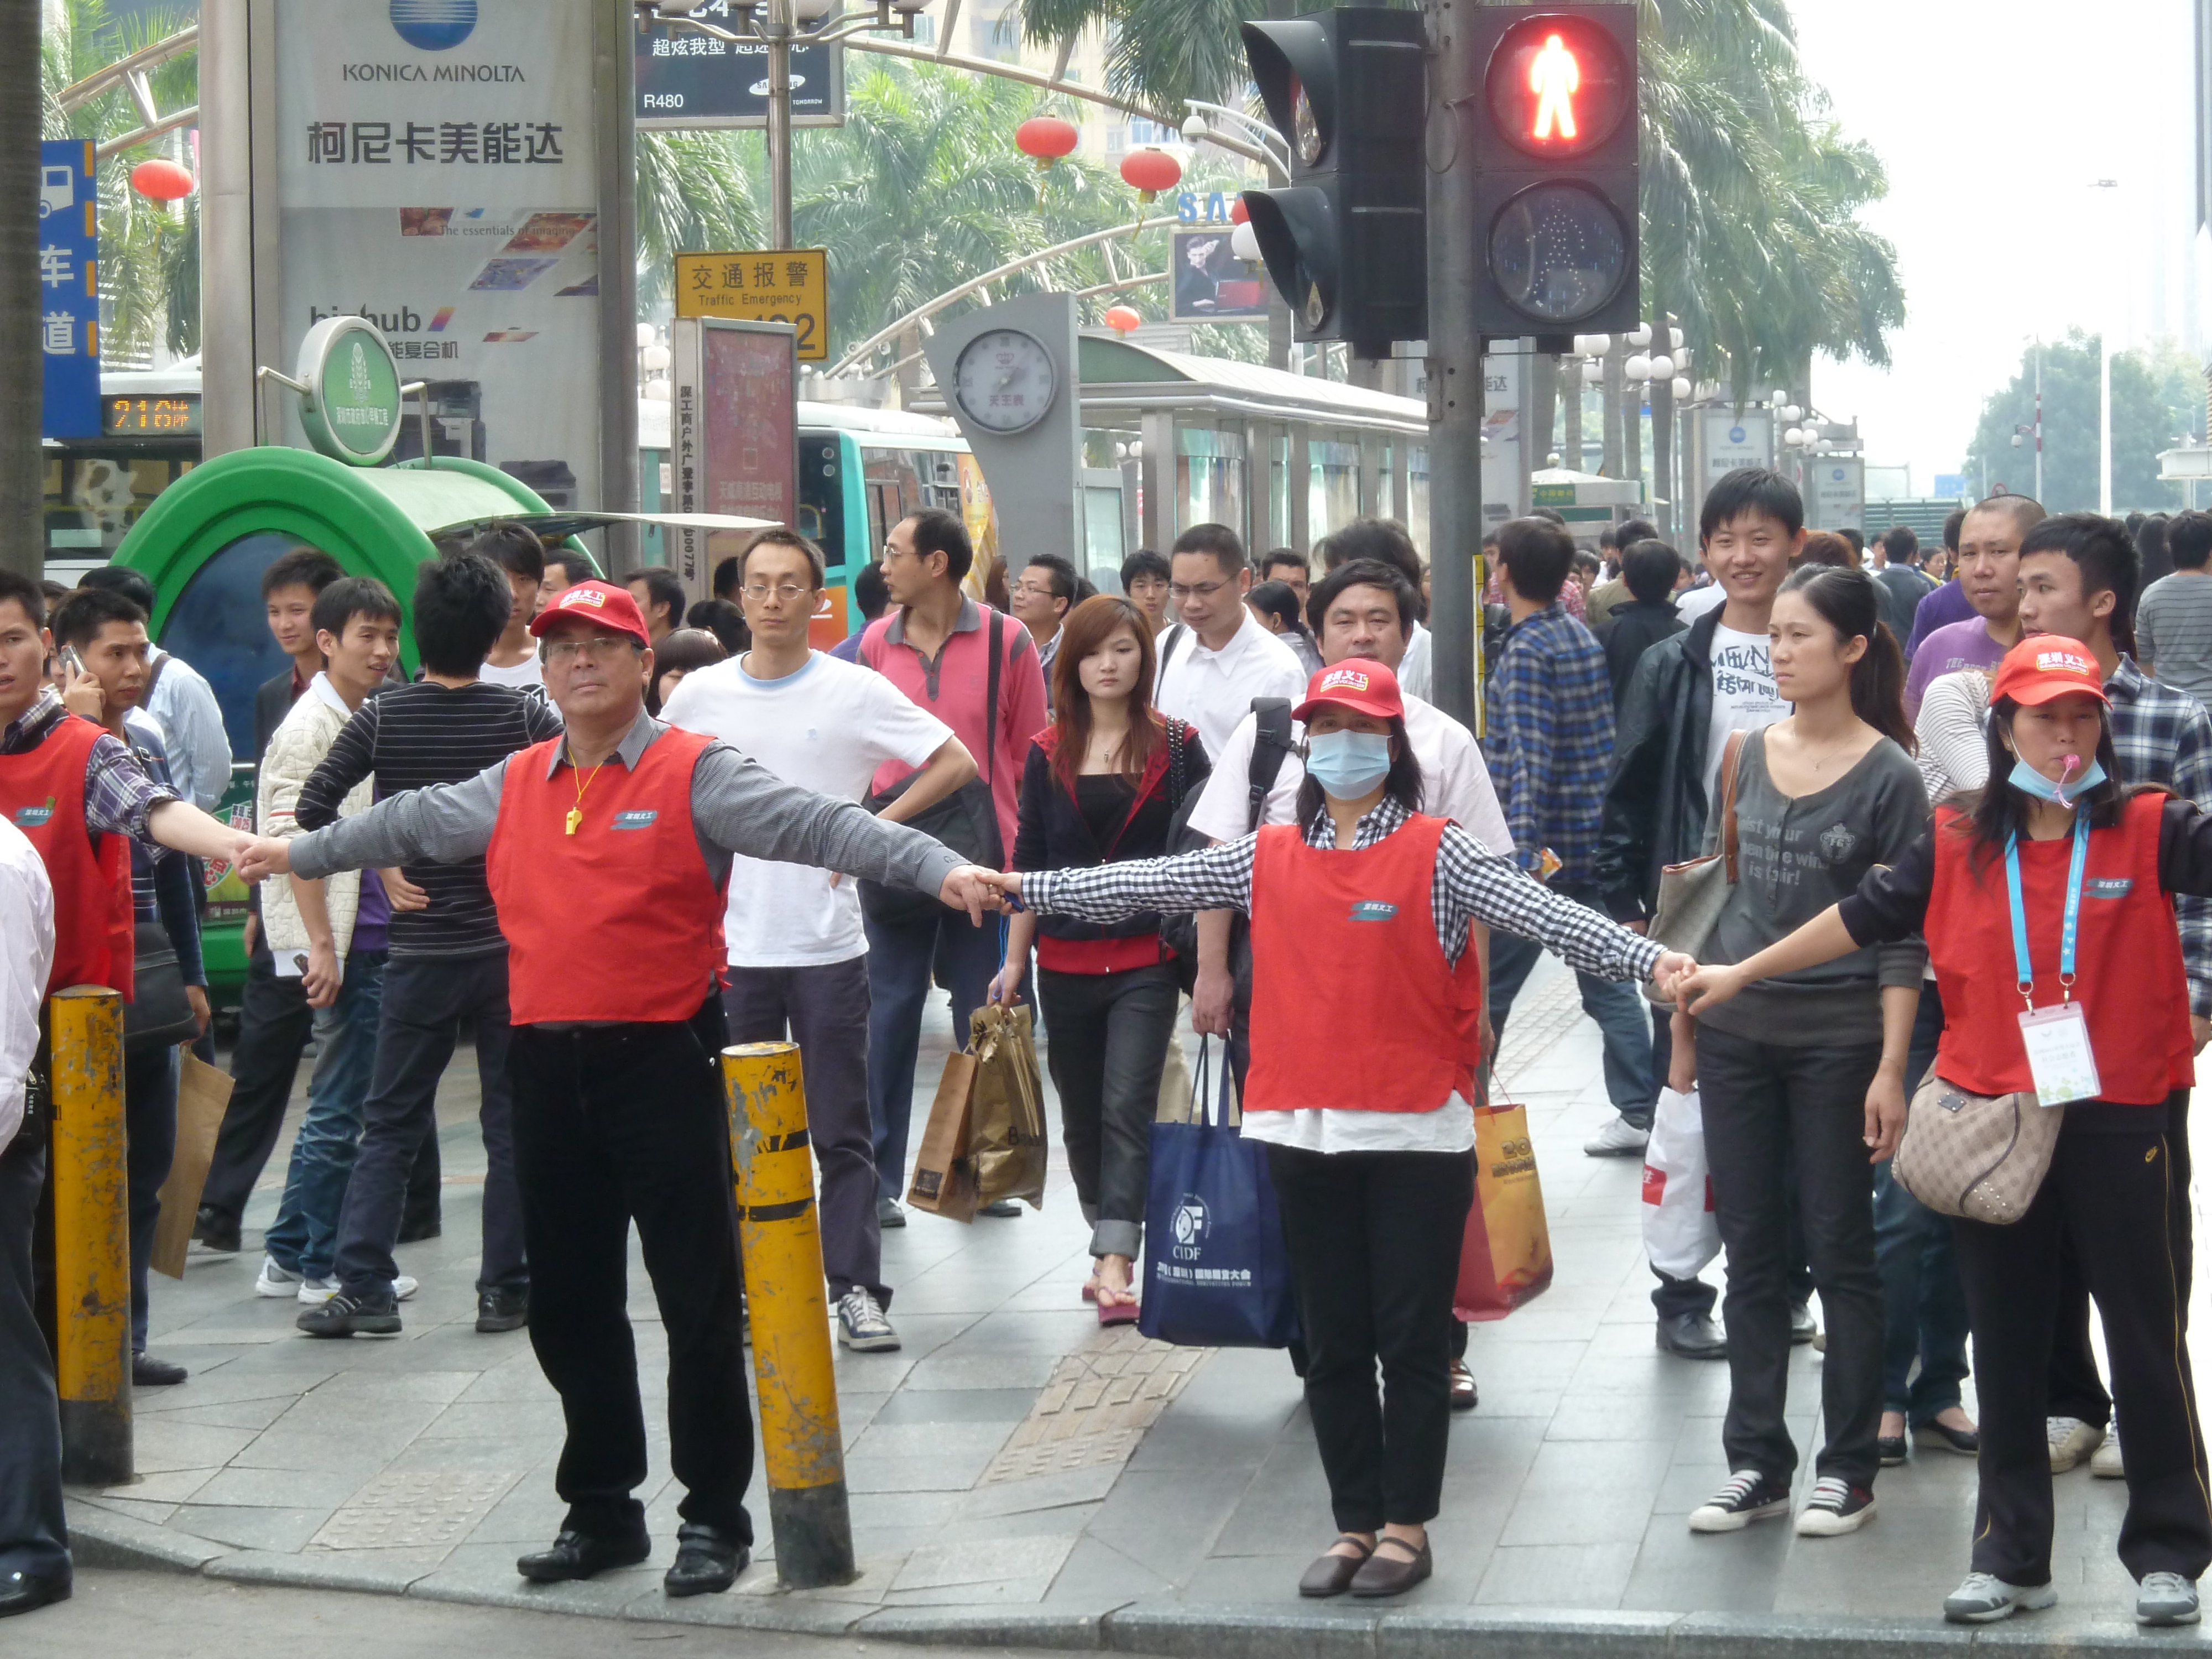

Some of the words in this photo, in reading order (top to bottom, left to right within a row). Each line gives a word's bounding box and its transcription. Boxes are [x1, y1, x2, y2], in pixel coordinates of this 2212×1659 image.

[653, 38, 726, 56] 超炫我型
[343, 64, 427, 81] KONICA
[434, 64, 525, 82] MINOLTA
[644, 94, 684, 108] R480
[307, 122, 563, 164] 柯尼卡美能达
[440, 225, 458, 236] The
[463, 225, 514, 236] essentials
[692, 261, 808, 290] 交通报警
[698, 294, 734, 306] Traffic
[742, 293, 802, 307] Emergency
[2037, 651, 2088, 667] 深圳义工
[1748, 861, 1763, 879] is
[1765, 866, 1801, 886] fair!
[1172, 1244, 1202, 1261] CIDF
